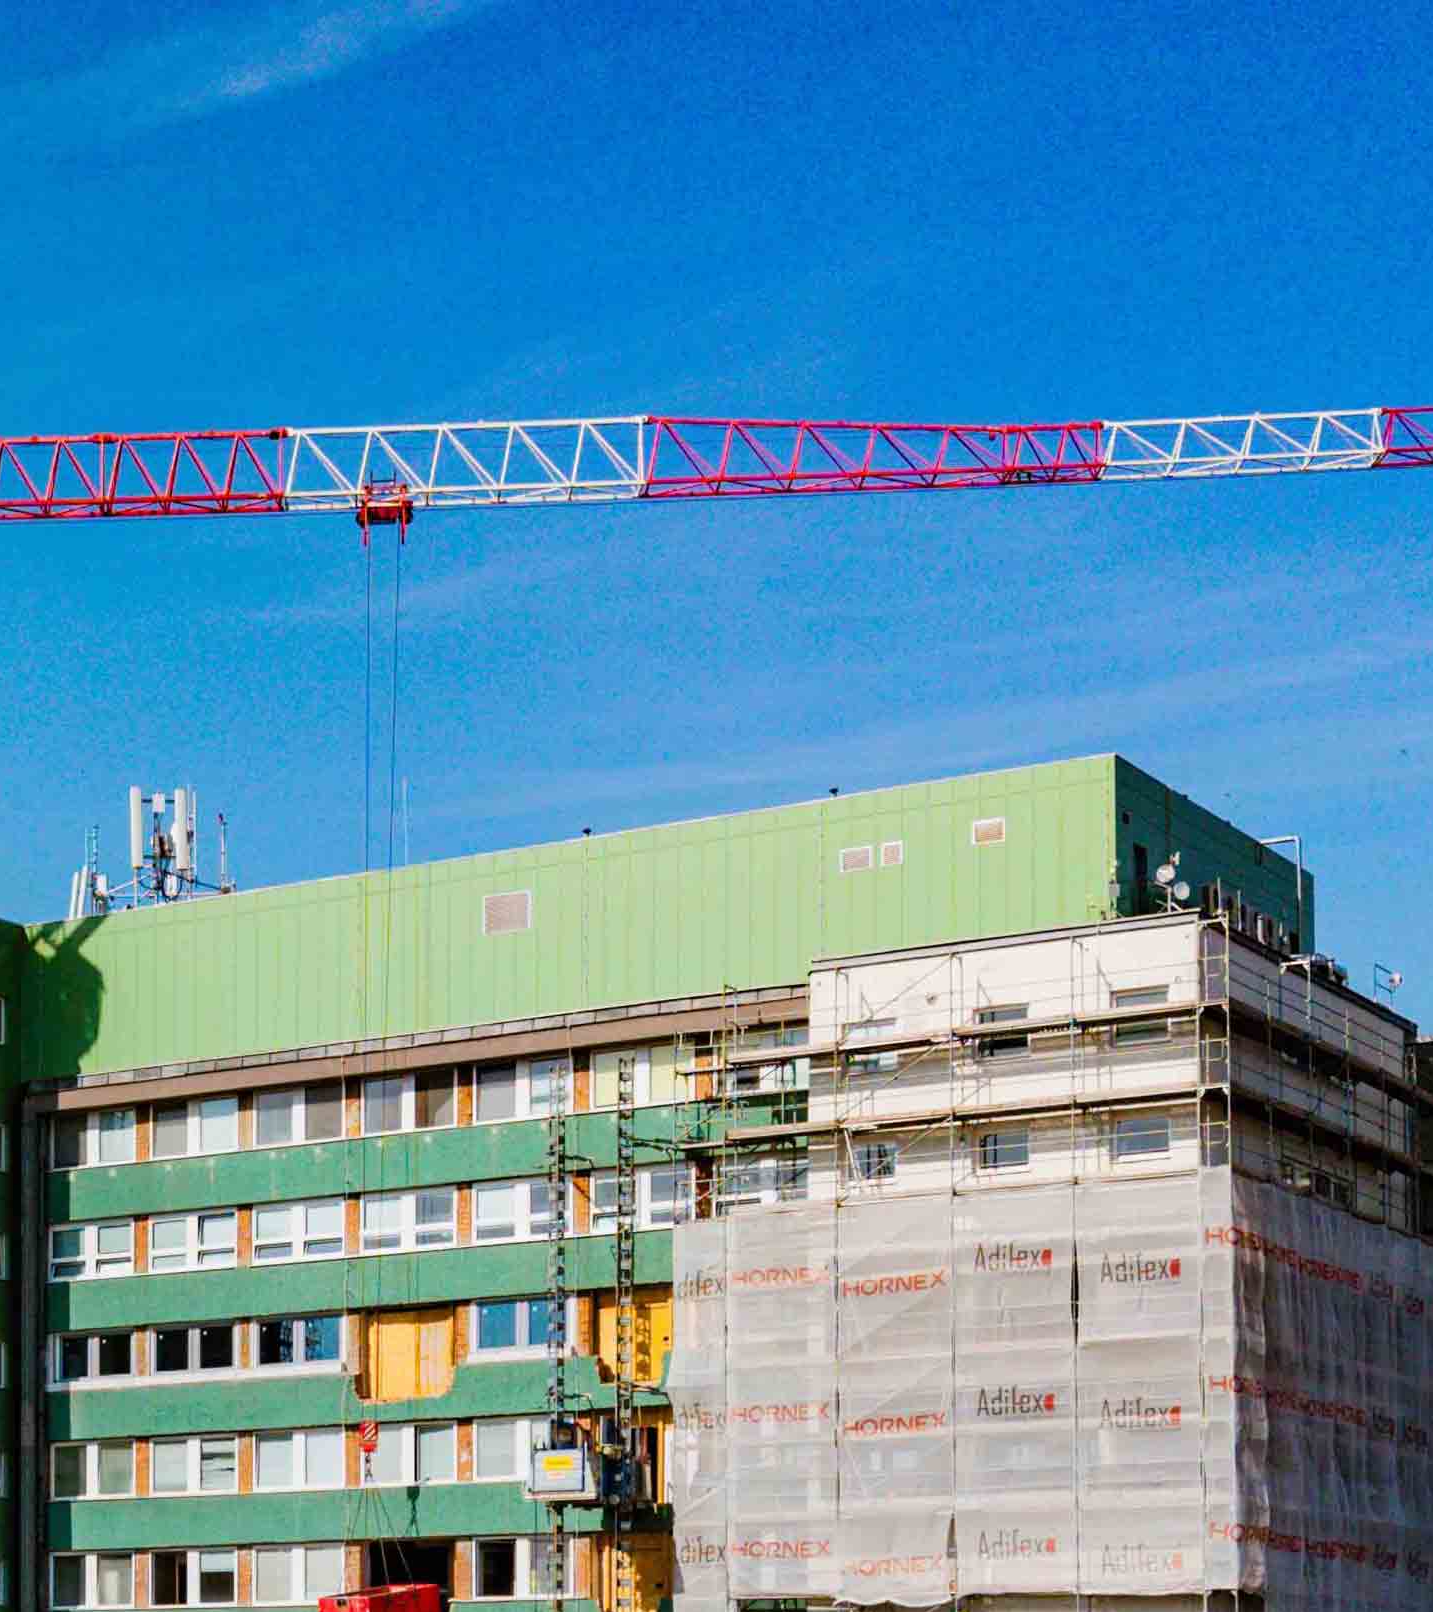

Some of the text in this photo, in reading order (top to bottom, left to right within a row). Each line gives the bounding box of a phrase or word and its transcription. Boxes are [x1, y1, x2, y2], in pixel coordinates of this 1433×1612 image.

[678, 1271, 724, 1299] difex
[731, 1264, 830, 1286] HORNEX
[843, 1269, 947, 1297] HORNEX
[679, 1403, 725, 1431] difex
[730, 1403, 830, 1426] HORNEX
[843, 1410, 946, 1437] HORNEX
[681, 1537, 725, 1564] difex
[731, 1539, 831, 1559] HORNEX
[842, 1553, 943, 1577] HORNEX
